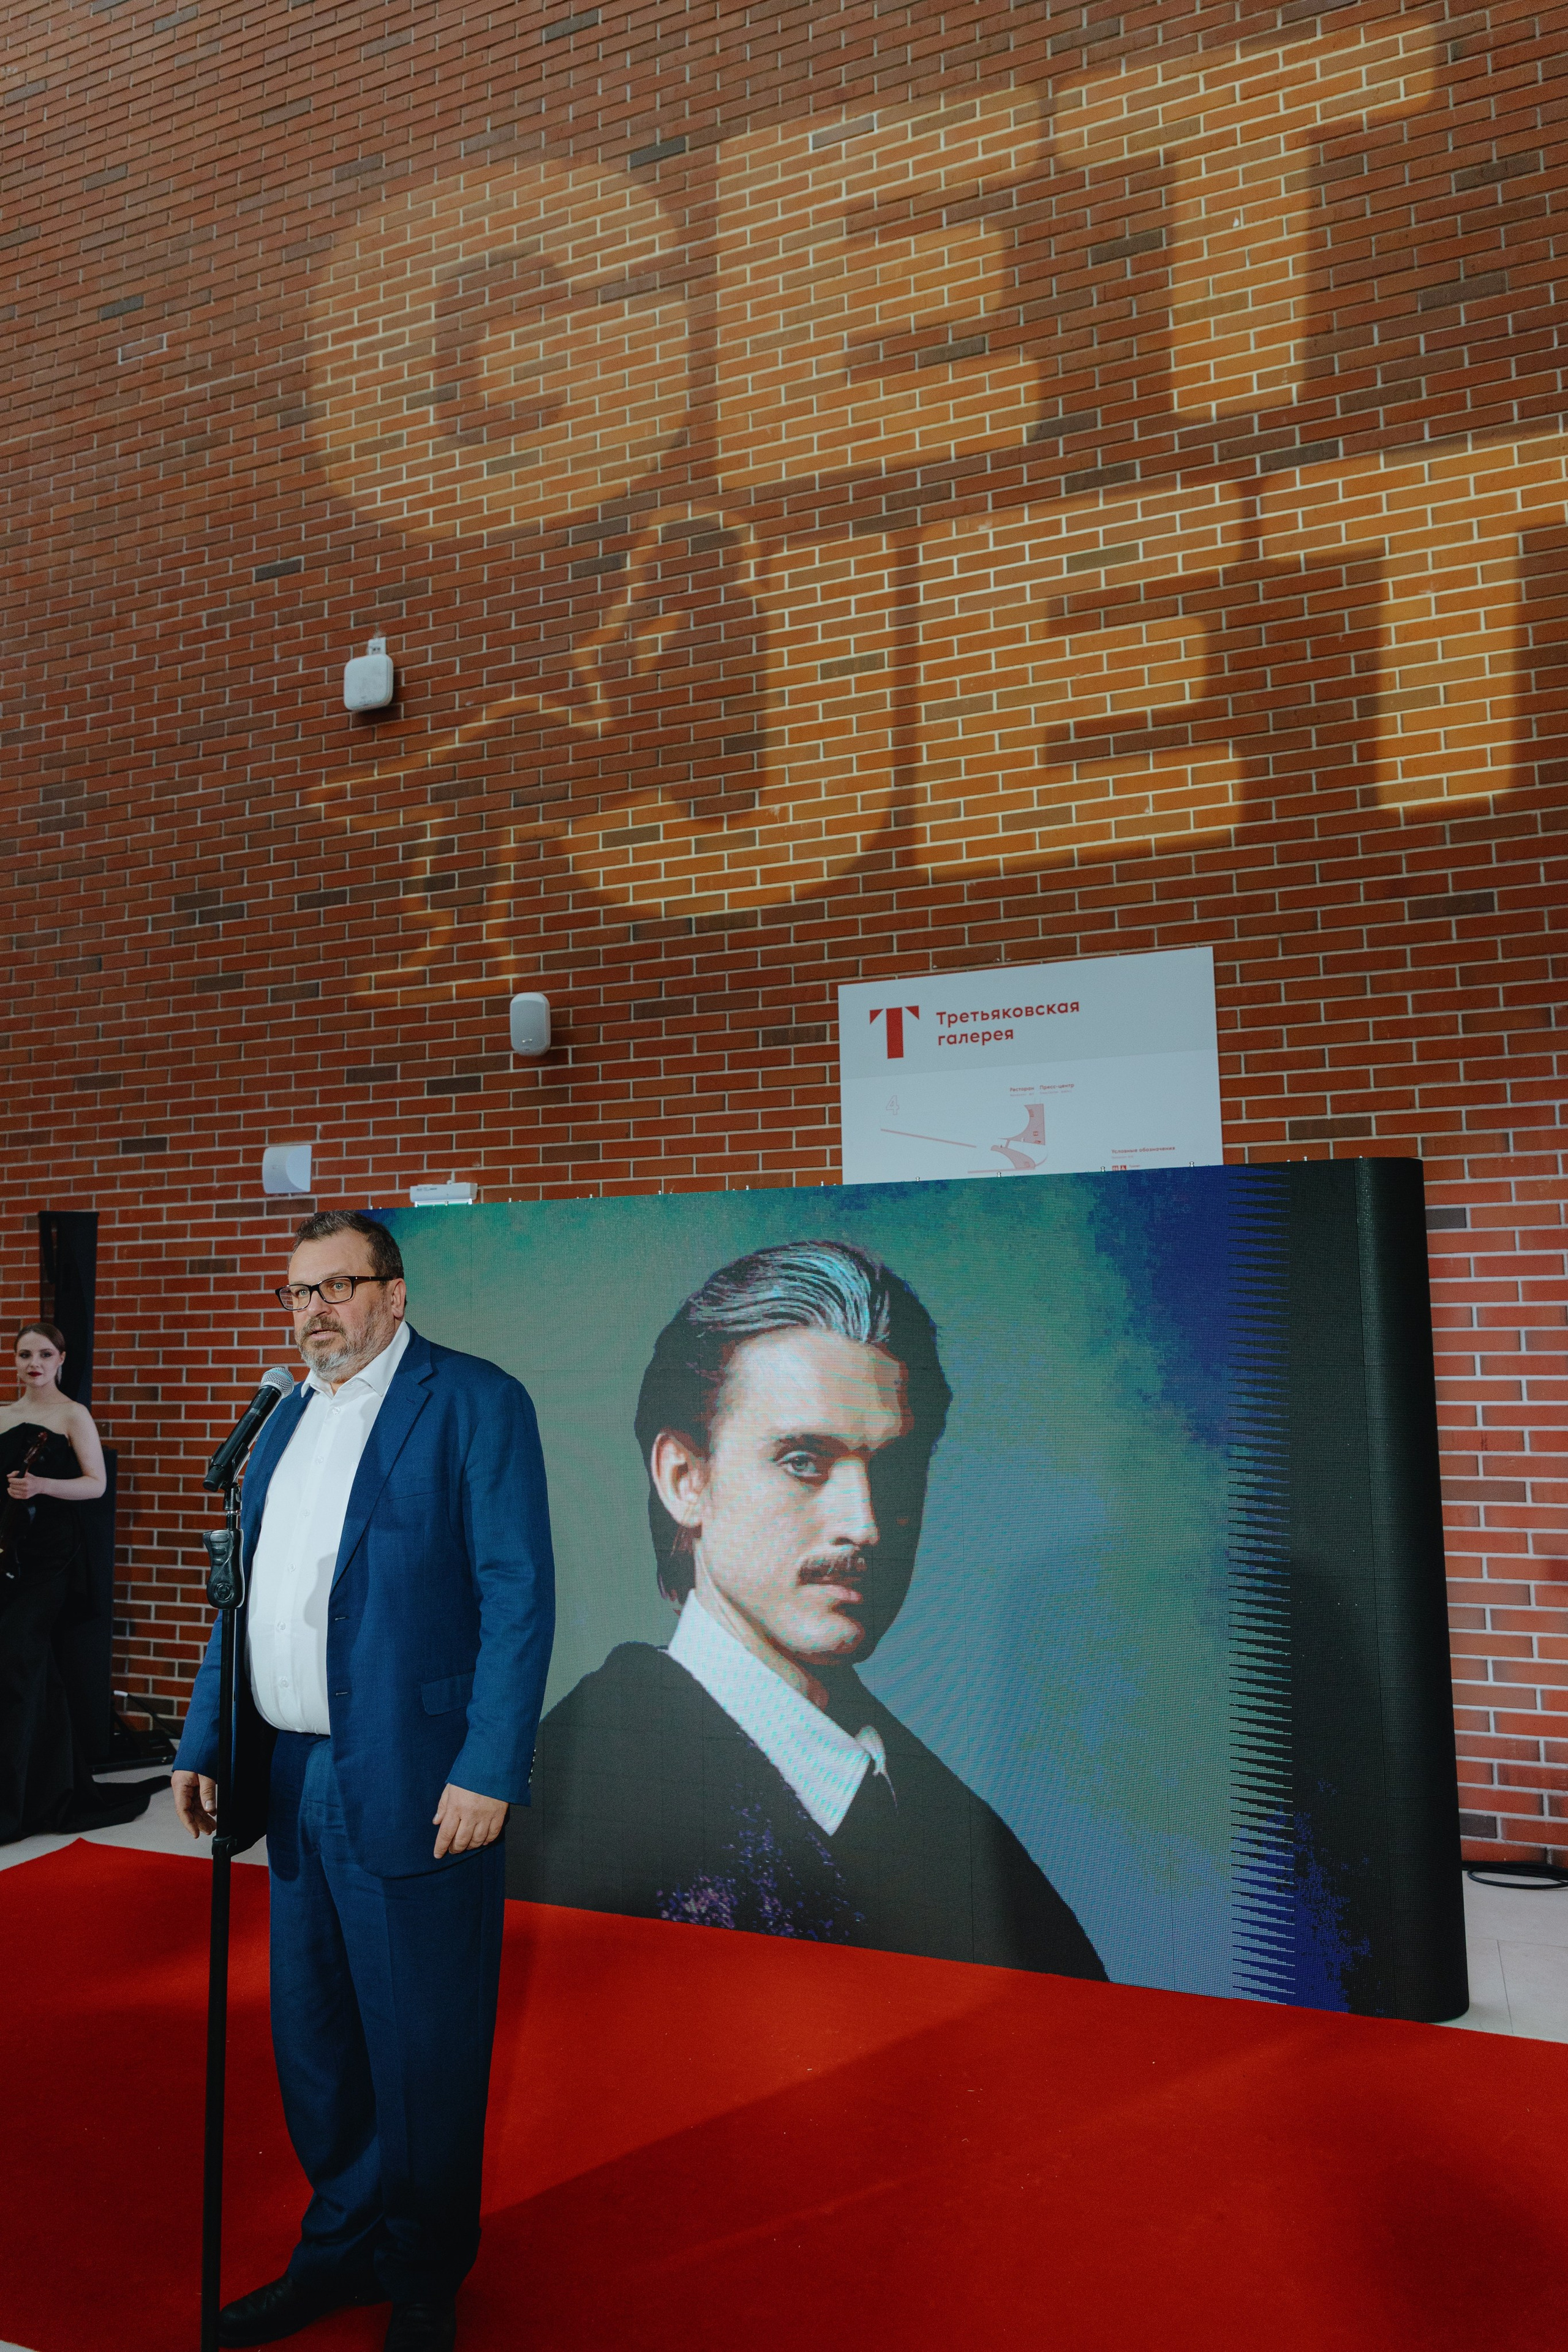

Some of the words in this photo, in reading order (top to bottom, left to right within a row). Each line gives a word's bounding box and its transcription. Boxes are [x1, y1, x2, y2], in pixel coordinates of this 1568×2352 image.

[311, 17, 1438, 544] GET
[936, 1001, 1080, 1027] Третьяковская
[937, 1029, 1014, 1047] галерея
[885, 1094, 900, 1116] 4
